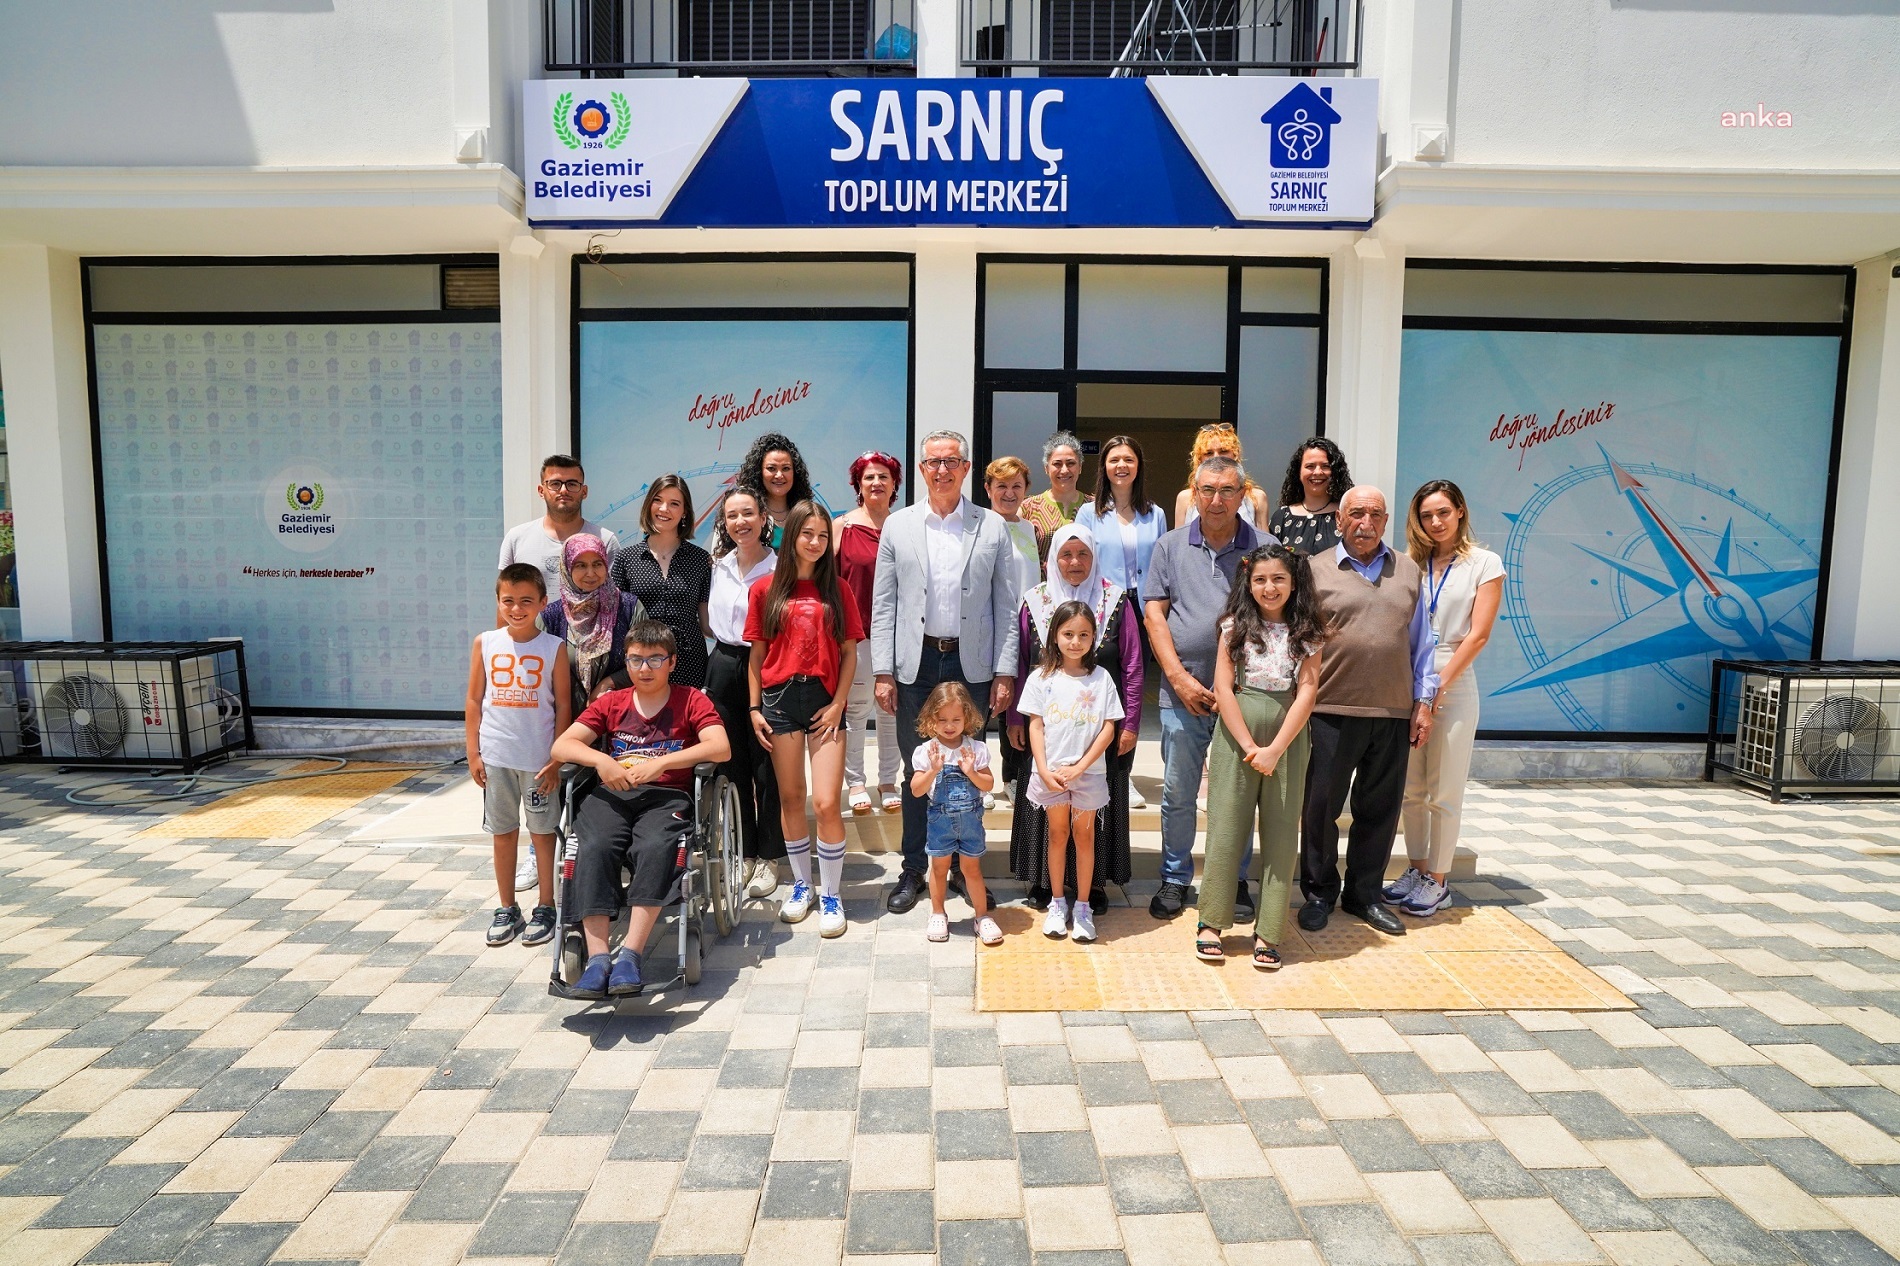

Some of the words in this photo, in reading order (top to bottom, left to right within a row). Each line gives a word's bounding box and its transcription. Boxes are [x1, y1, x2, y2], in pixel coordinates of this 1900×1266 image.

[830, 89, 1064, 176] SARNIÇ
[541, 158, 644, 177] Gaziemir
[1270, 171, 1297, 179] GAZİEMİR
[1298, 171, 1329, 179] BELEDİYESİ
[534, 180, 651, 202] Belediyesi
[825, 180, 937, 212] TOPLUM
[947, 174, 1068, 212] MERKEZİ
[1271, 182, 1328, 203] SARNIÇ
[1269, 203, 1297, 211] TOPLUM
[1298, 202, 1329, 211] MERKEZİ
[688, 394, 735, 429] doğru
[718, 380, 812, 450] yöndesiniz
[1490, 413, 1539, 449] doğru
[1519, 401, 1616, 471] yöndesiniz
[281, 513, 331, 523] Gaziemir
[278, 524, 335, 536] Belediyesi
[300, 568, 332, 578] herkesle
[491, 653, 544, 690] 83
[491, 689, 539, 702] LEGEND
